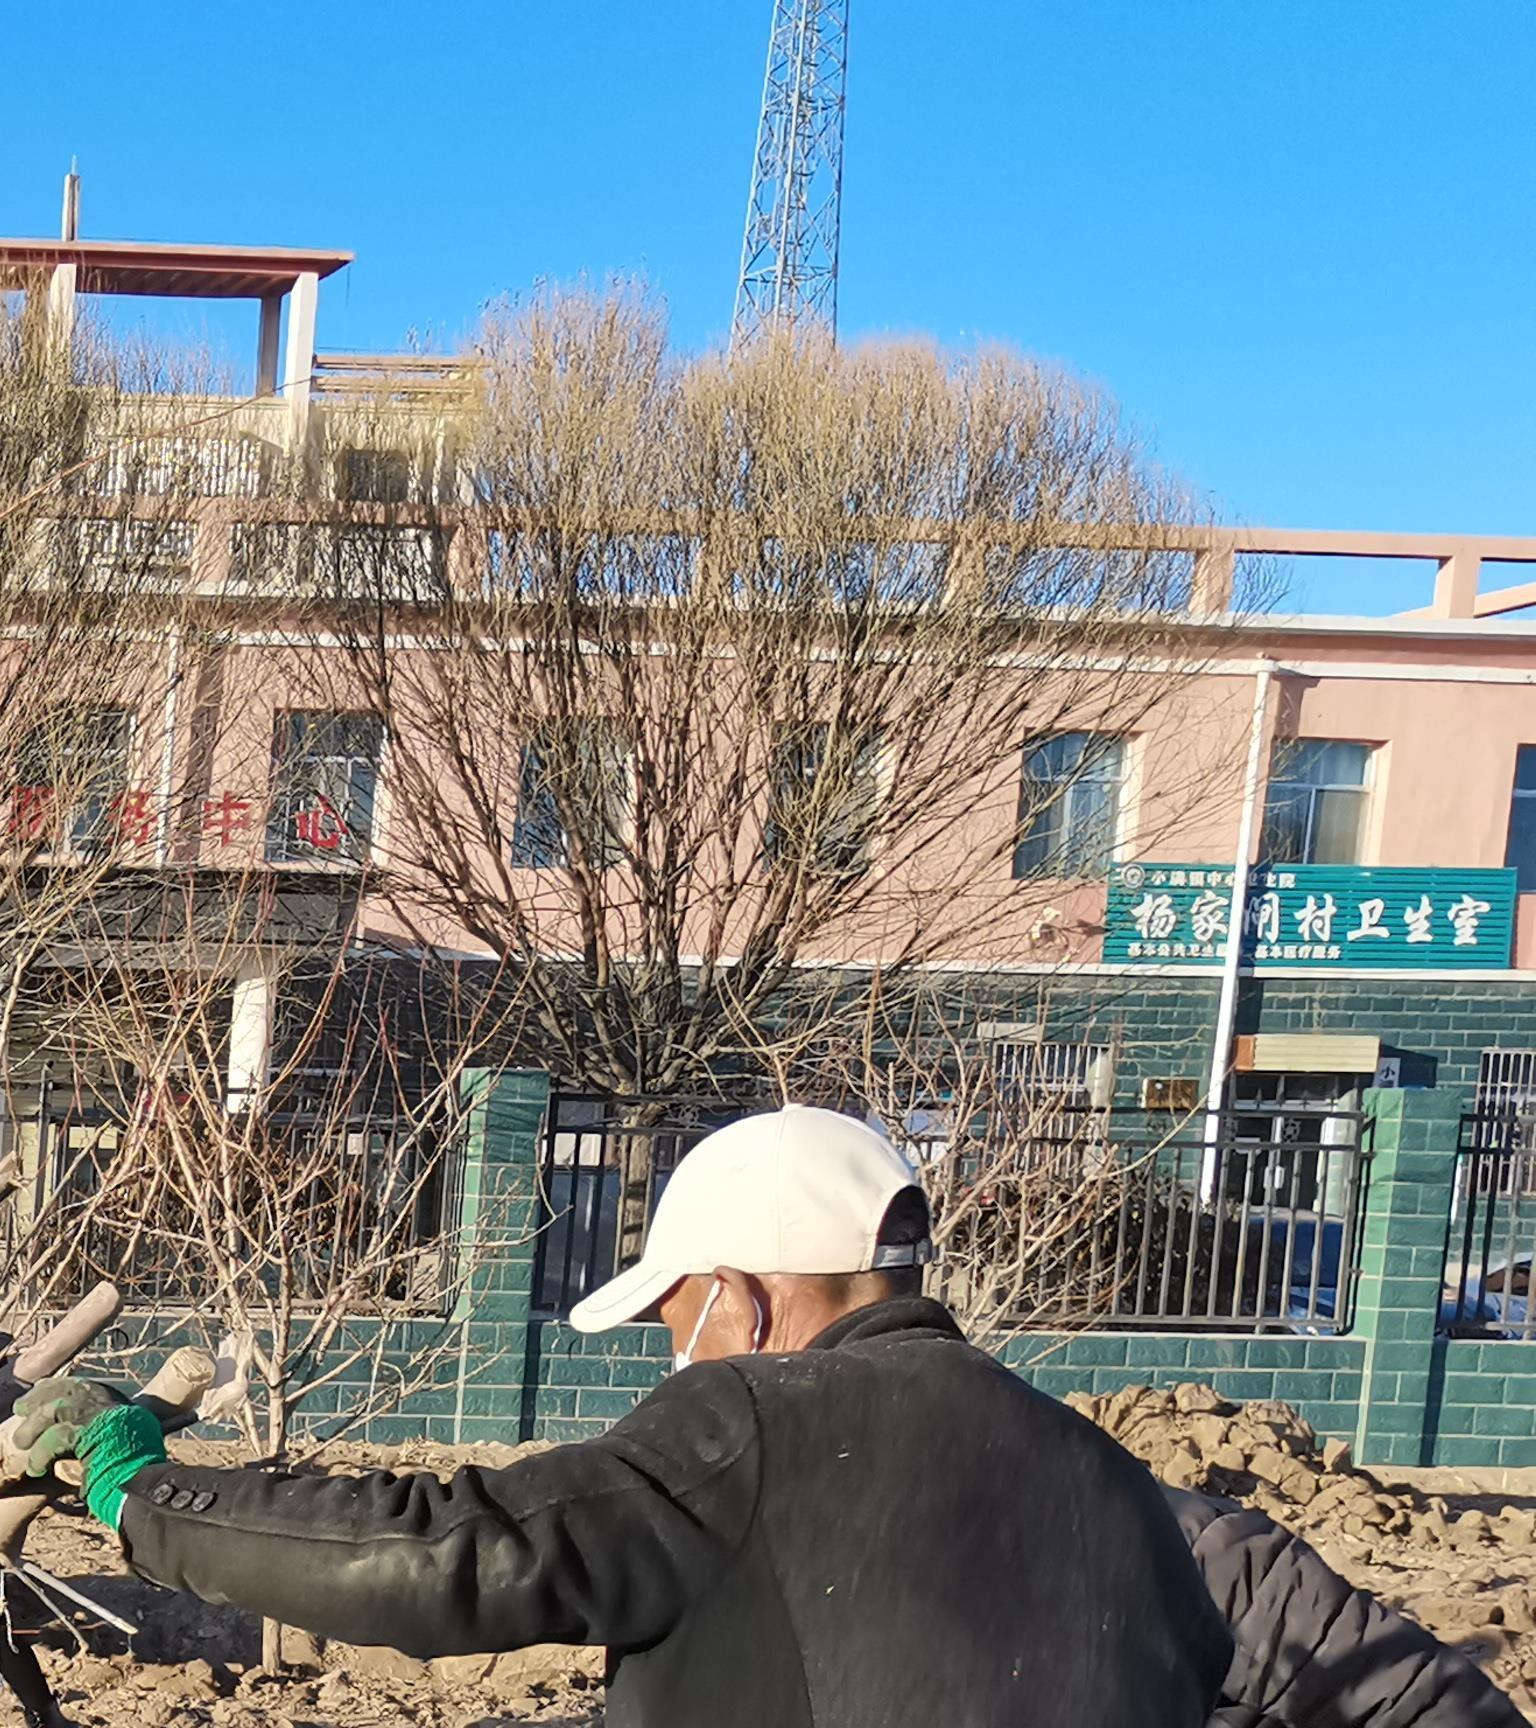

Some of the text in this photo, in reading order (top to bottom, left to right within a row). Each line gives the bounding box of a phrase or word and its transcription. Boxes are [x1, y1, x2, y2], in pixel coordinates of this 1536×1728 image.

[1131, 889, 1492, 946] 杨家闸村卫生室
